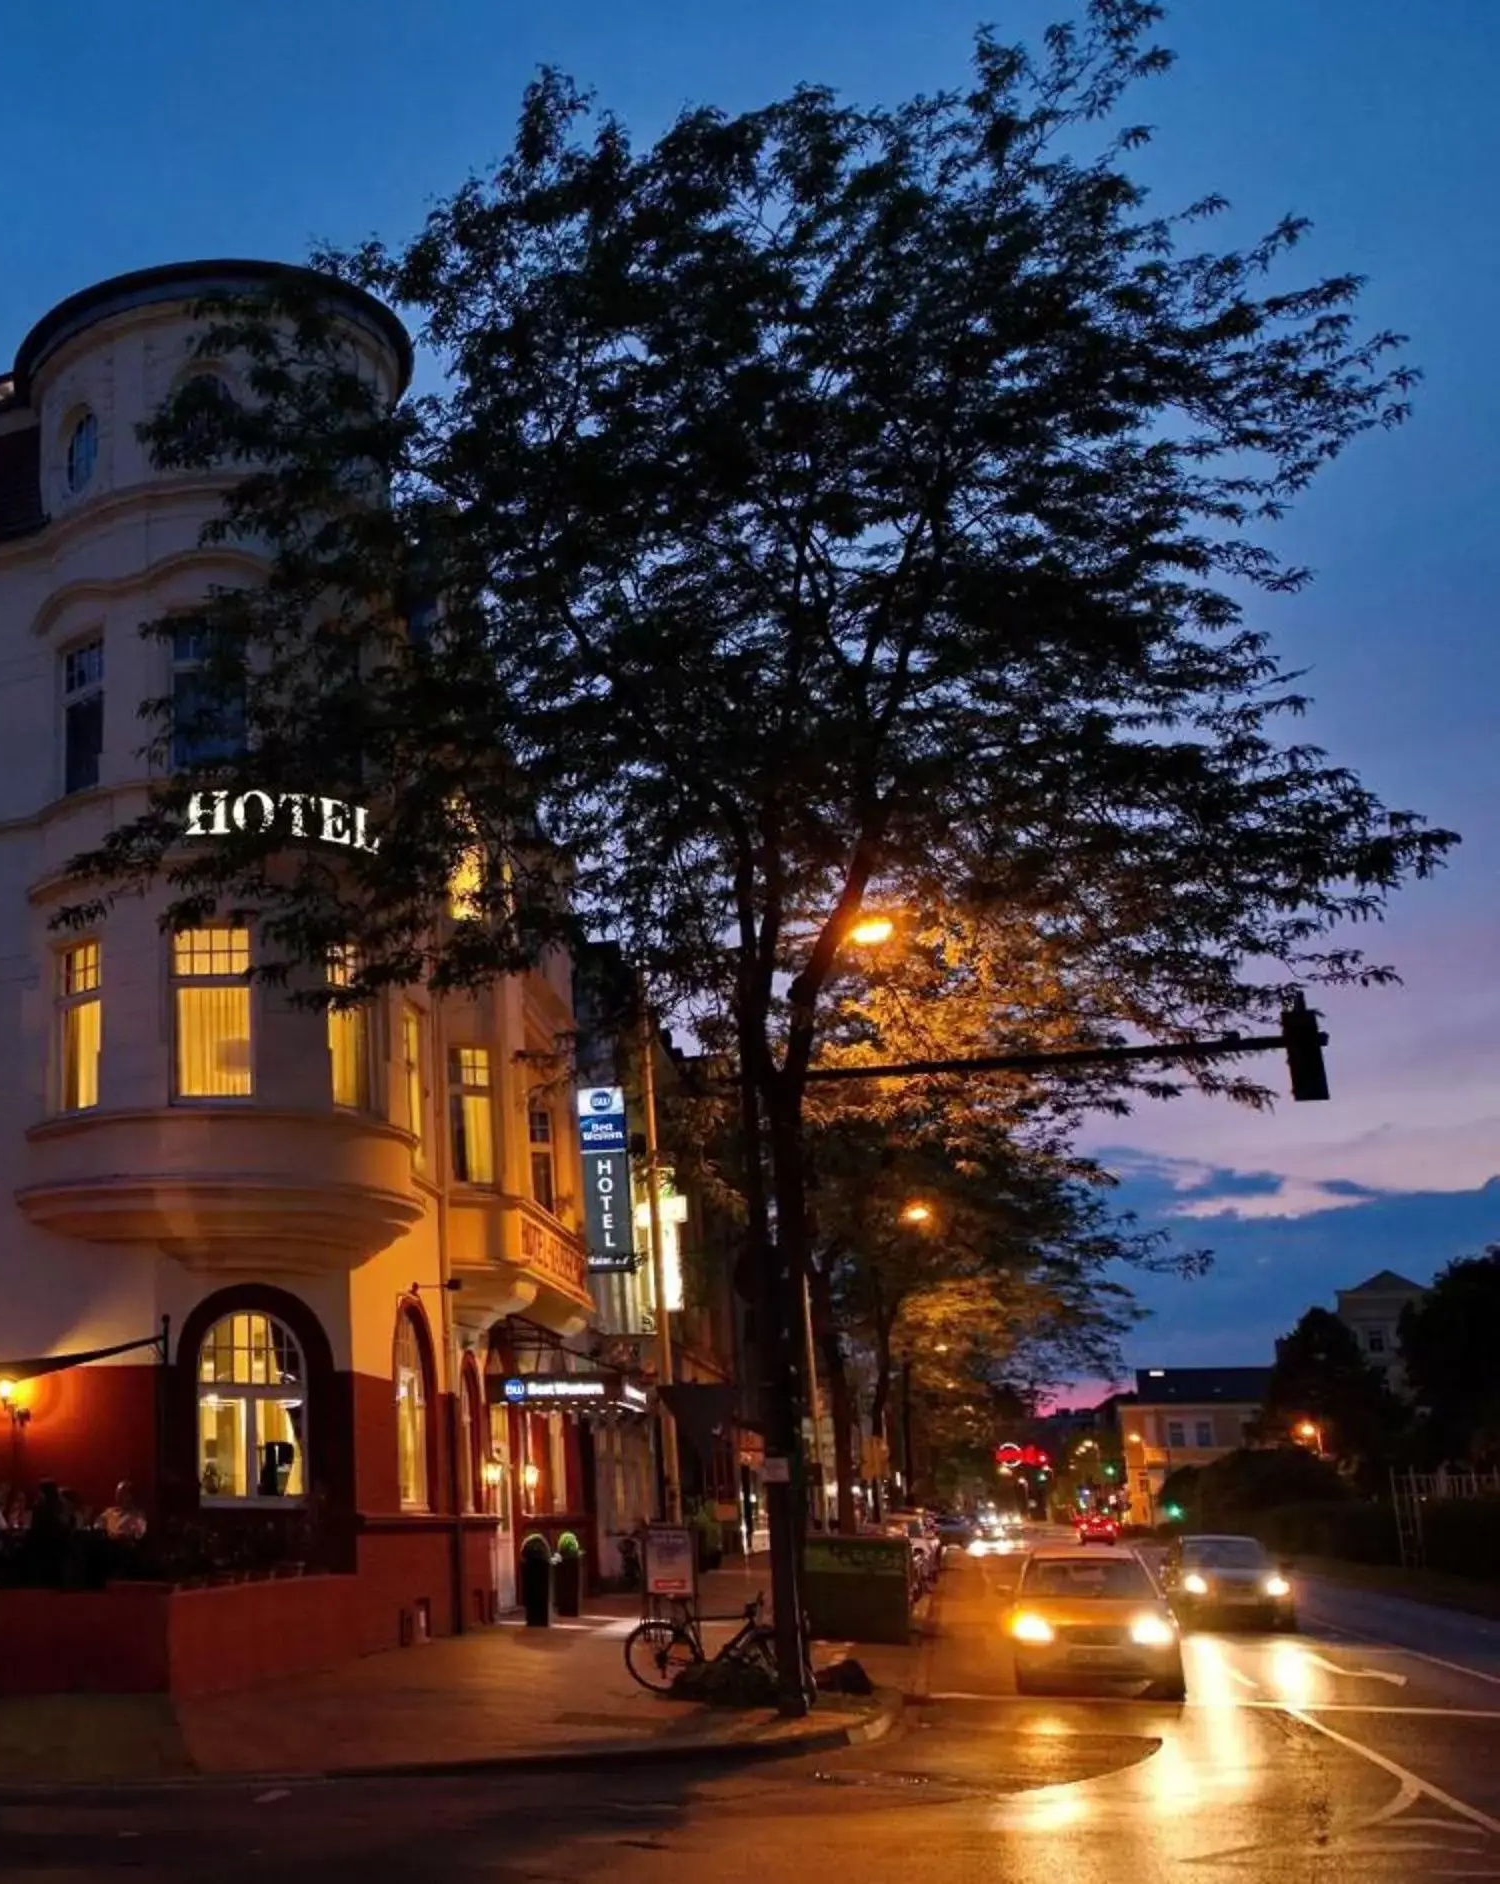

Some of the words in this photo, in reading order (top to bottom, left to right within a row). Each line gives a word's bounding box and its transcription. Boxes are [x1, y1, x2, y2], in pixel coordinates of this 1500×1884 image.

[184, 788, 383, 856] HOTEL
[582, 1130, 624, 1141] Western
[591, 1122, 614, 1132] Best
[596, 1159, 617, 1248] HOTEL
